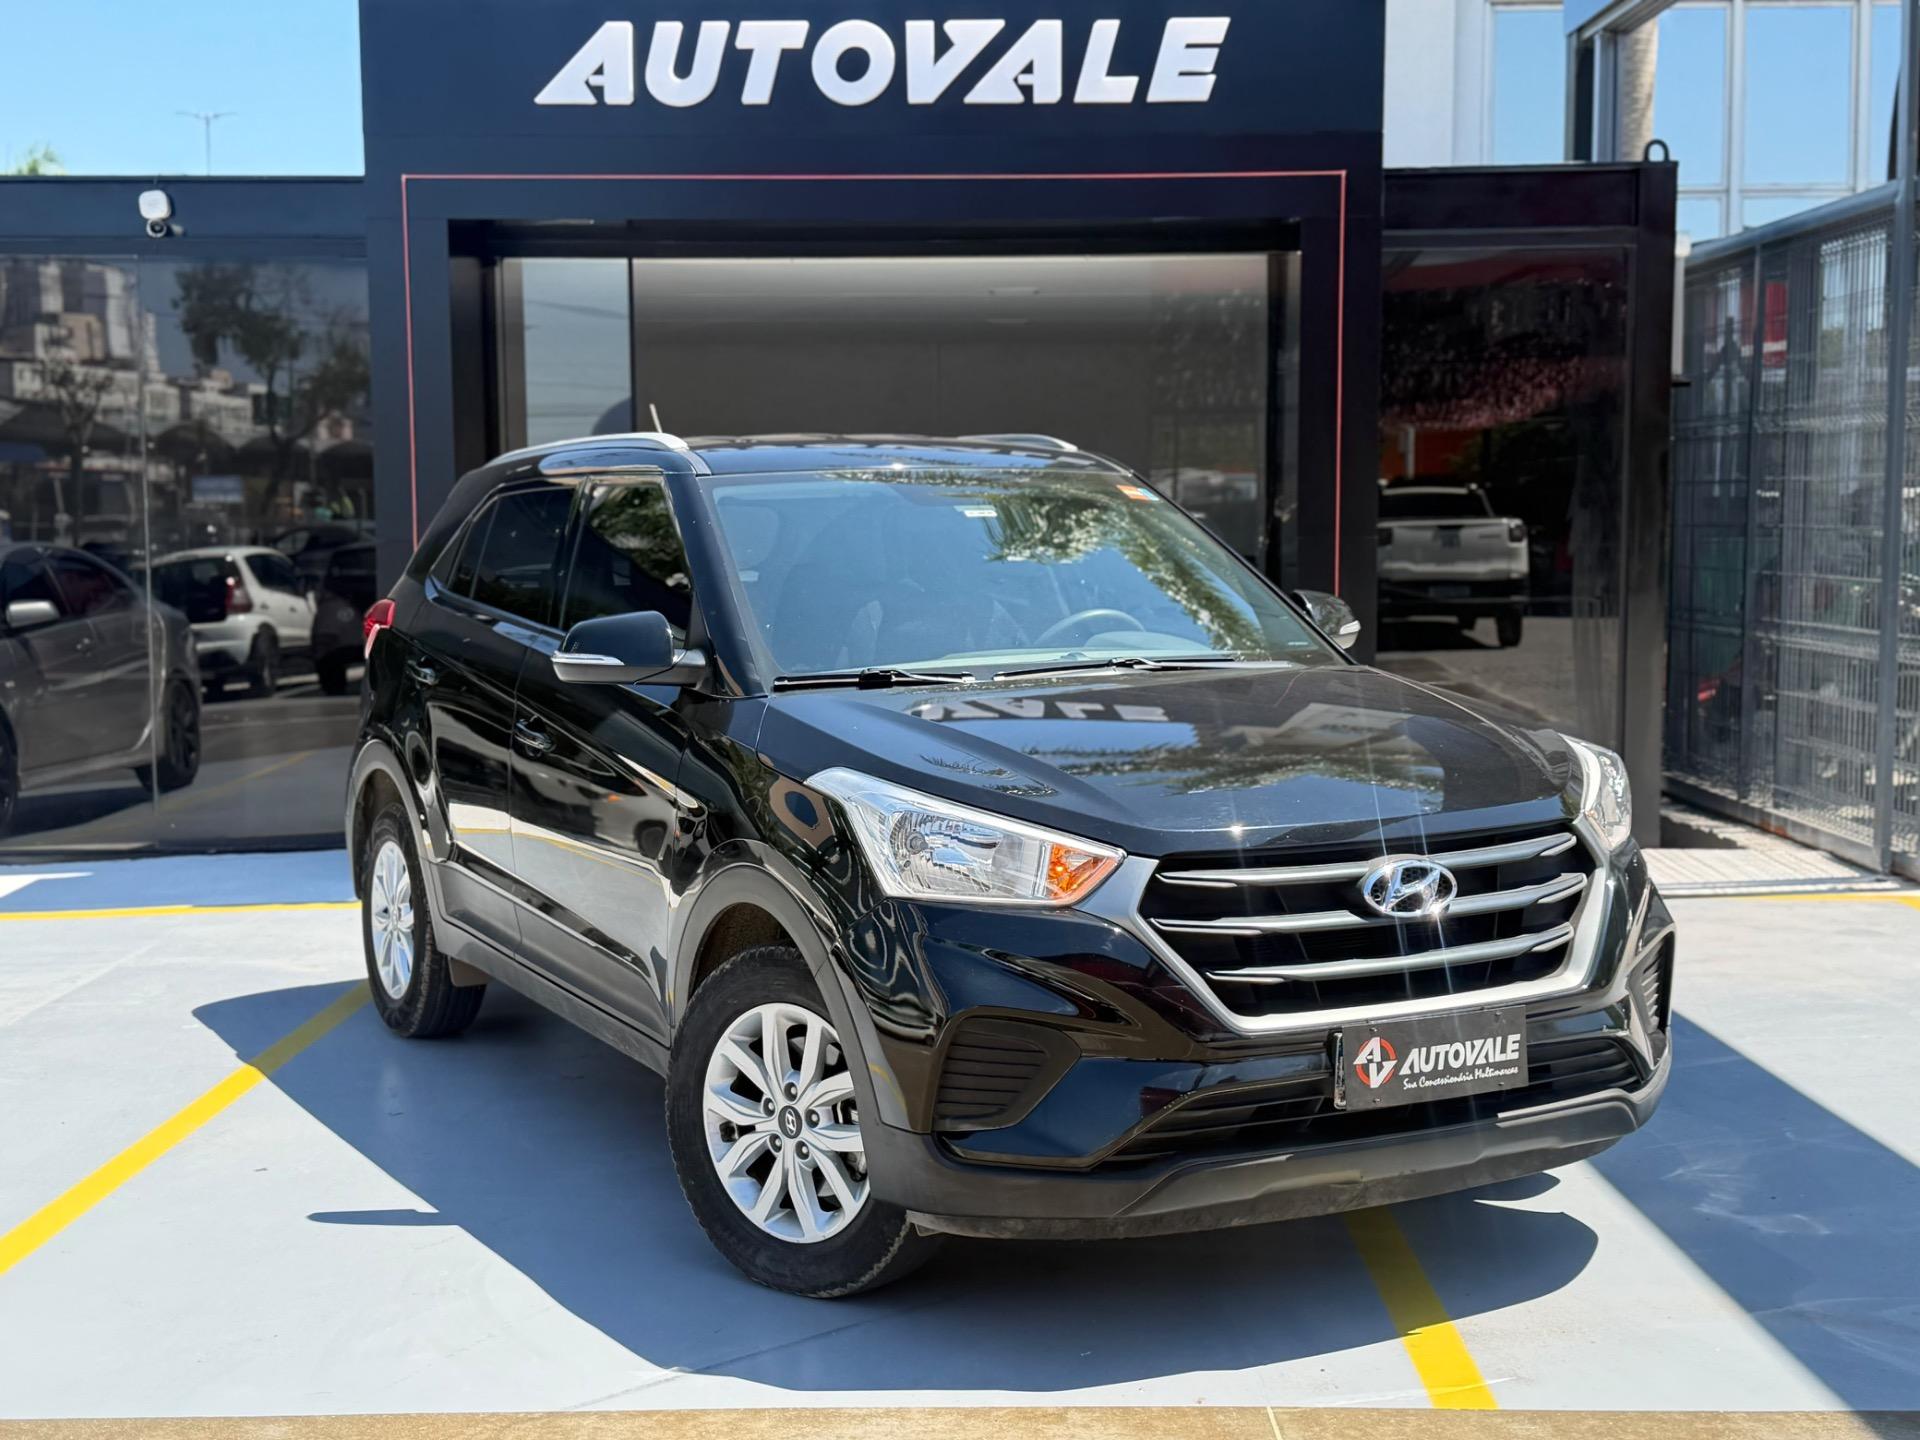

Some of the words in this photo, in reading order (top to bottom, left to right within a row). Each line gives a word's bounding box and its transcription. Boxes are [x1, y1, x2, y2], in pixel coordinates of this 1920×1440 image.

[534, 17, 1230, 107] AUTOVALE
[1399, 1033, 1521, 1075] AUTOVALE
[1403, 1078, 1418, 1090] Sua
